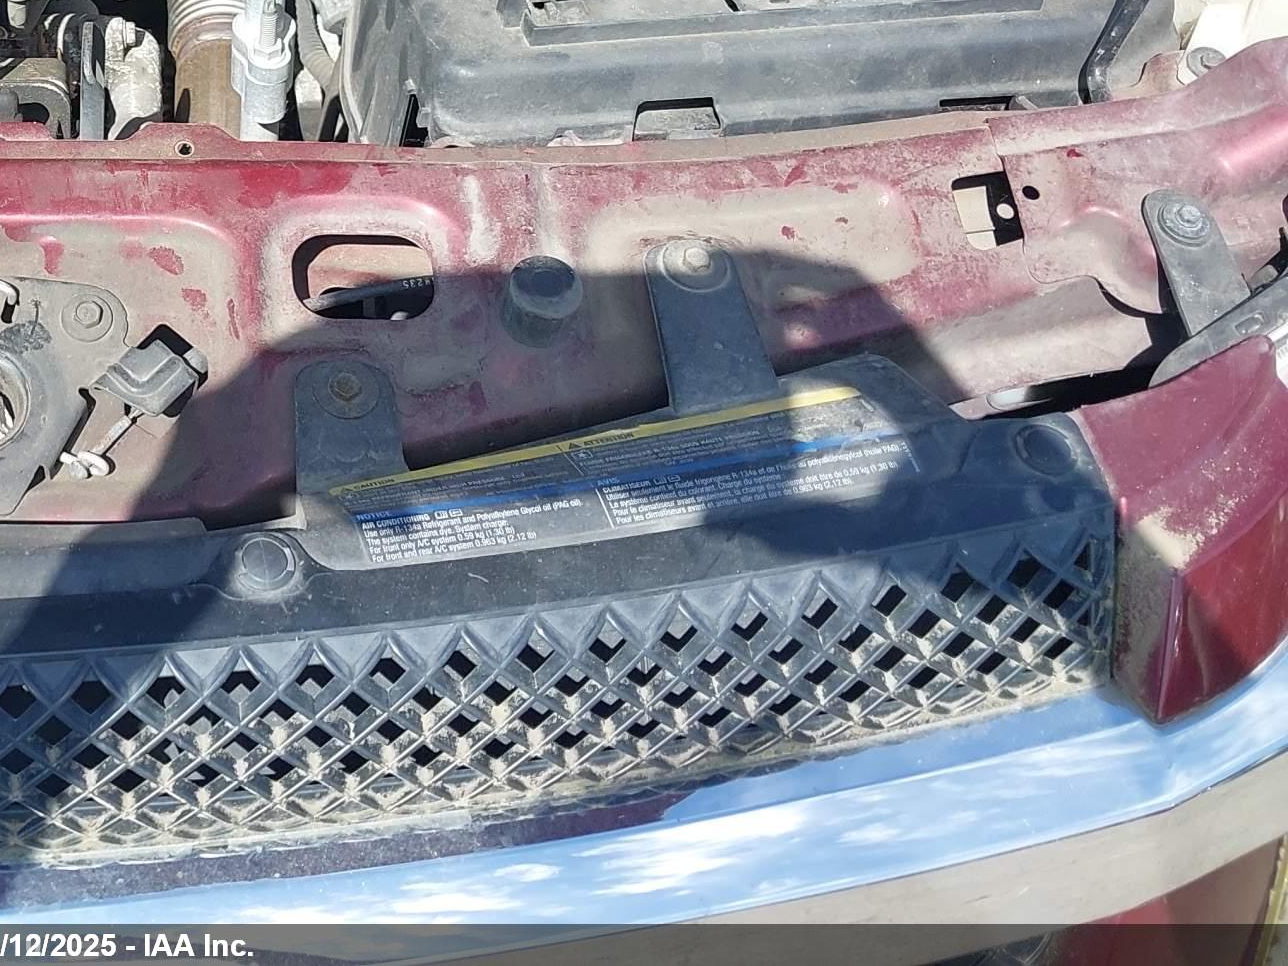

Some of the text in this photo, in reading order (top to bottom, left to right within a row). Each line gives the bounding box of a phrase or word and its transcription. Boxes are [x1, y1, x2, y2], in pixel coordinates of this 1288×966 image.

[353, 478, 395, 491] CAUTION
[356, 511, 391, 522] NOTICE
[362, 513, 430, 530] AIR CONDITIONING
[364, 530, 378, 538] Use
[379, 528, 394, 538] only
[394, 524, 422, 534] R-134a
[422, 516, 462, 530] Refrigerant
[462, 514, 476, 524] and
[520, 504, 542, 515] Glycol
[542, 504, 552, 512] oil
[552, 500, 570, 512] (PAG
[366, 538, 380, 546] The
[382, 534, 408, 546] system
[408, 529, 438, 540] contains
[454, 522, 482, 534] System
[370, 546, 381, 555] For
[382, 544, 400, 553] front
[400, 541, 416, 551] only
[417, 538, 430, 547] A/C
[431, 535, 457, 546] system
[475, 529, 484, 538] kg
[486, 526, 504, 538] (1.30
[505, 526, 516, 535] lb)
[372, 531, 537, 563] For front and rear A/C system 0.963 kg (2.12 lb)
